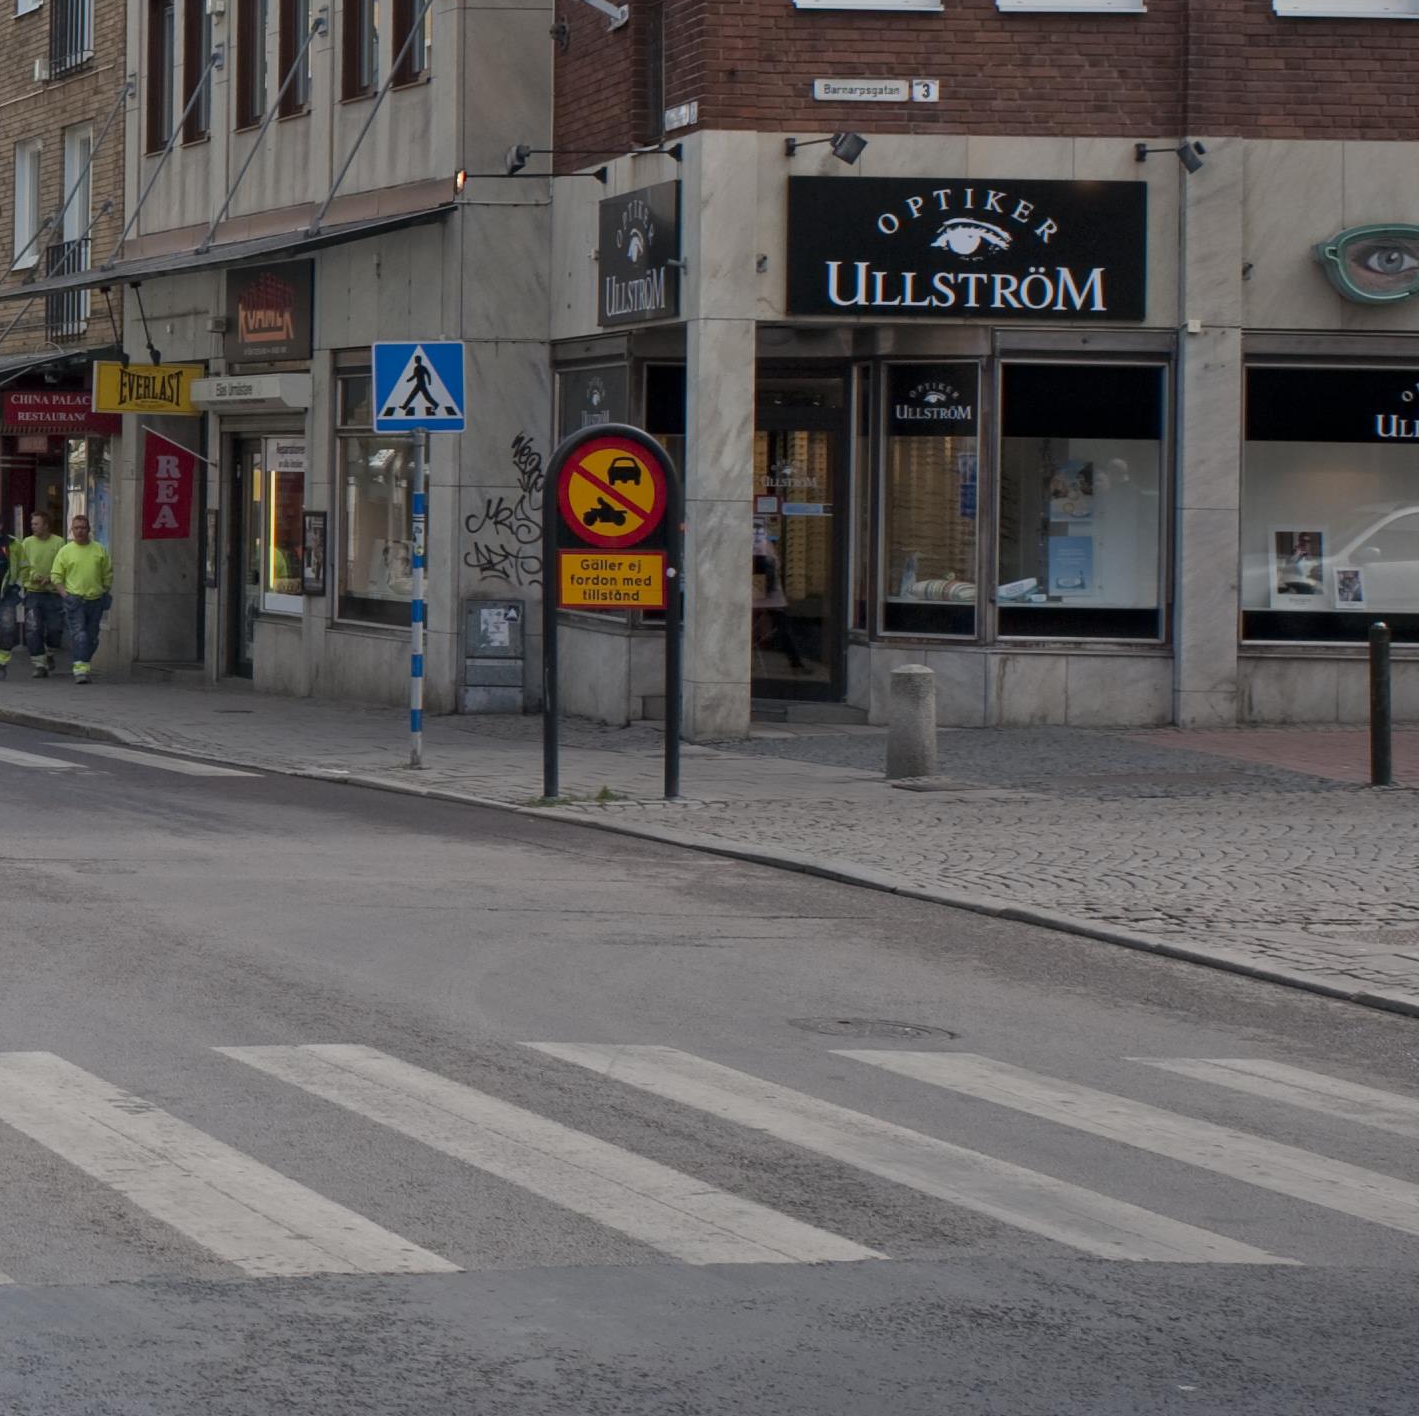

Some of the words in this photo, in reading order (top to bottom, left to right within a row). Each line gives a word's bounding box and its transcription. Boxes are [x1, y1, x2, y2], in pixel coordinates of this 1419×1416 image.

[824, 84, 900, 97] Barnarpsgatan
[922, 83, 931, 98] 3
[877, 188, 1058, 244] OPTIKER
[825, 261, 1108, 312] ULLSTRÖM
[118, 368, 183, 406] EVERLAST
[11, 394, 49, 406] CHINA
[52, 394, 91, 406] PALAC
[896, 405, 972, 420] ULLSTRÖM
[152, 455, 182, 529] REA
[581, 559, 623, 571] Gäller
[629, 560, 642, 574] ej
[570, 575, 617, 586] fordon
[623, 575, 652, 586] med
[583, 589, 640, 601] tillstånd
